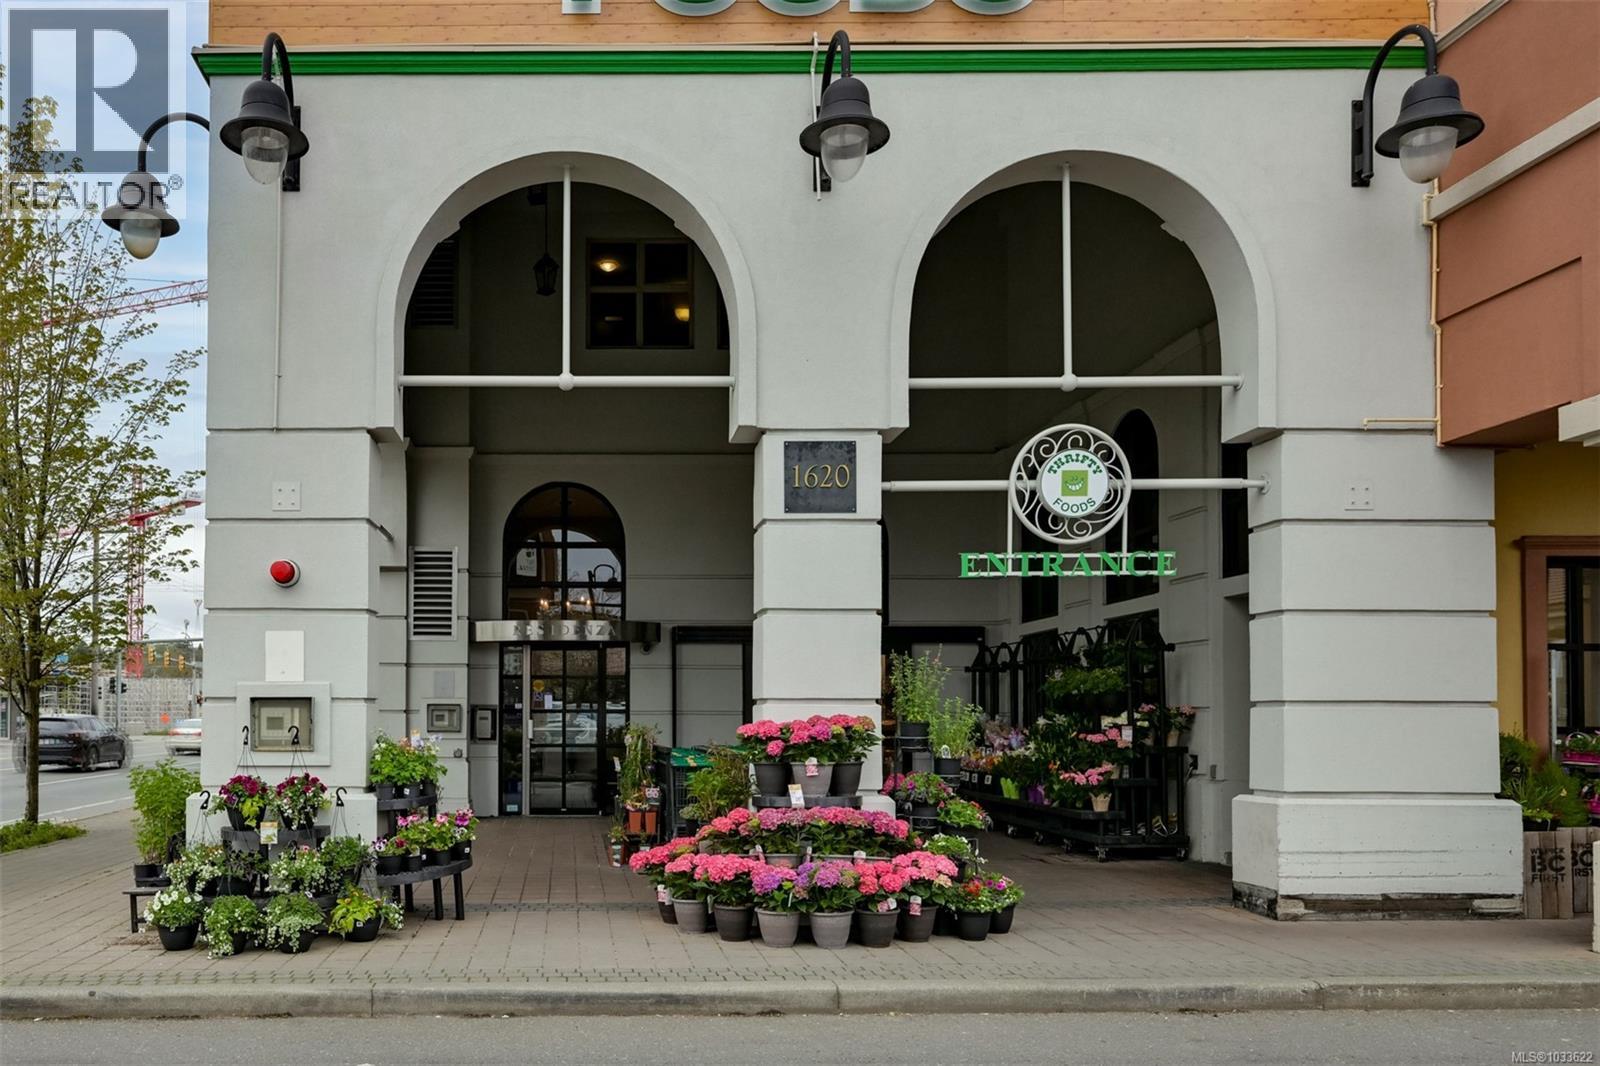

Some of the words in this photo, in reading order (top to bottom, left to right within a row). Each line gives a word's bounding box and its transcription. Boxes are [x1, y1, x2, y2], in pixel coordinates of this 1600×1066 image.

[1047, 453, 1103, 475] THRIFTY
[792, 464, 850, 489] 1620
[1052, 498, 1096, 514] FOODS
[958, 551, 1178, 578] ENTRANCE
[513, 624, 616, 637] RESIDENZA
[1531, 854, 1566, 873] BC
